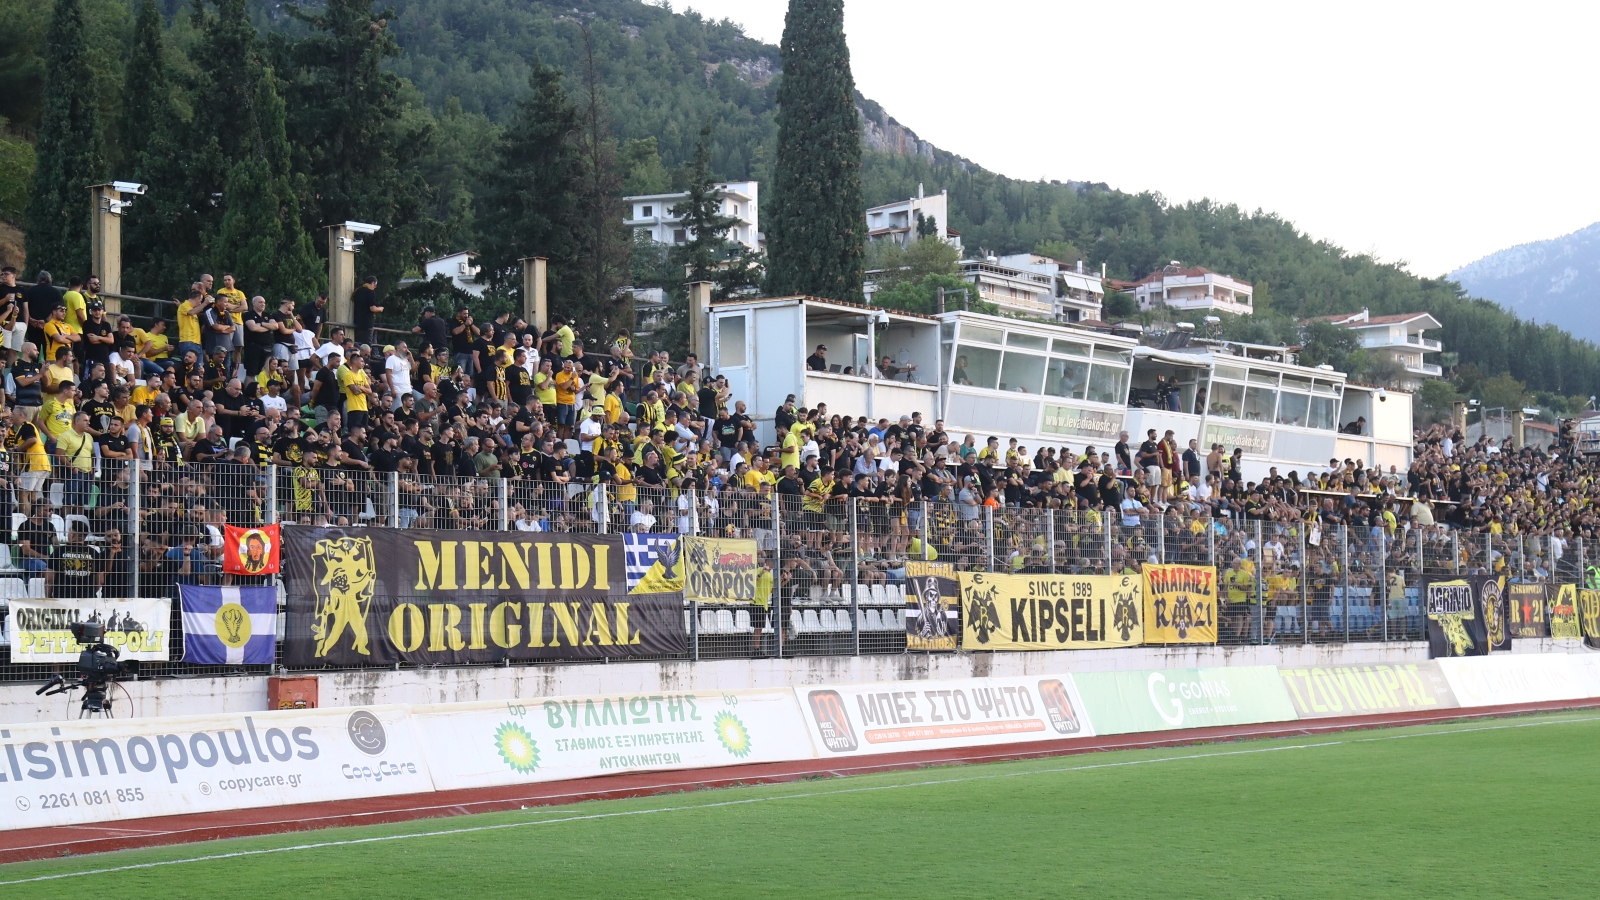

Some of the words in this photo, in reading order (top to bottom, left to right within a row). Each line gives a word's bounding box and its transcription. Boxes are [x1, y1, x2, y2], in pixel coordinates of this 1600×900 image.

[1045, 413, 1120, 433] www.levadiakosfc.gr
[1207, 431, 1268, 449] www.levadiakosfc.gr
[414, 541, 610, 591] MENIDI
[690, 570, 755, 600] OROPOS
[1029, 581, 1065, 596] SINCE
[1072, 582, 1092, 597] 1989
[1150, 568, 1212, 596] ΠΛΑΤΑΙΕΣ
[1010, 598, 1106, 643] KIPSELI
[1154, 597, 1170, 629] R
[1194, 601, 1213, 628] 21
[1511, 599, 1521, 623] R
[1532, 599, 1544, 623] 21
[388, 602, 641, 653] ORIGINAL
[722, 692, 738, 708] bp
[1179, 680, 1231, 700] GONIAS
[1280, 663, 1437, 714] ΤΖΟΥΝΑΡΑΣ
[507, 701, 526, 719] bp
[544, 694, 702, 729] ΒΥΛΛΙΩΤΗΣ
[856, 691, 924, 726] ΜΠΕΣ
[924, 688, 971, 722] ΣΤΟ
[971, 685, 1036, 717] ΨΗΤΟ
[1188, 707, 1209, 715] ENERGY
[1215, 704, 1238, 713] SYSTEMS
[555, 735, 613, 752] ΣΤΑΘΜΟΣ
[615, 731, 705, 748] ΕΞΥΠΗΡΕΤΗΣΗΣ
[823, 729, 836, 738] ΣΤΟ
[826, 737, 849, 749] ΨΗΤΟ
[0, 716, 320, 784] isimopoulos
[599, 752, 682, 769] ΑΥΤΟΚΙΝΗΤΩΝ
[341, 759, 417, 782] CopyCare
[218, 772, 303, 793] copycare.gr
[40, 791, 80, 810] 2261
[84, 788, 115, 806] 081
[118, 786, 145, 803] 855
